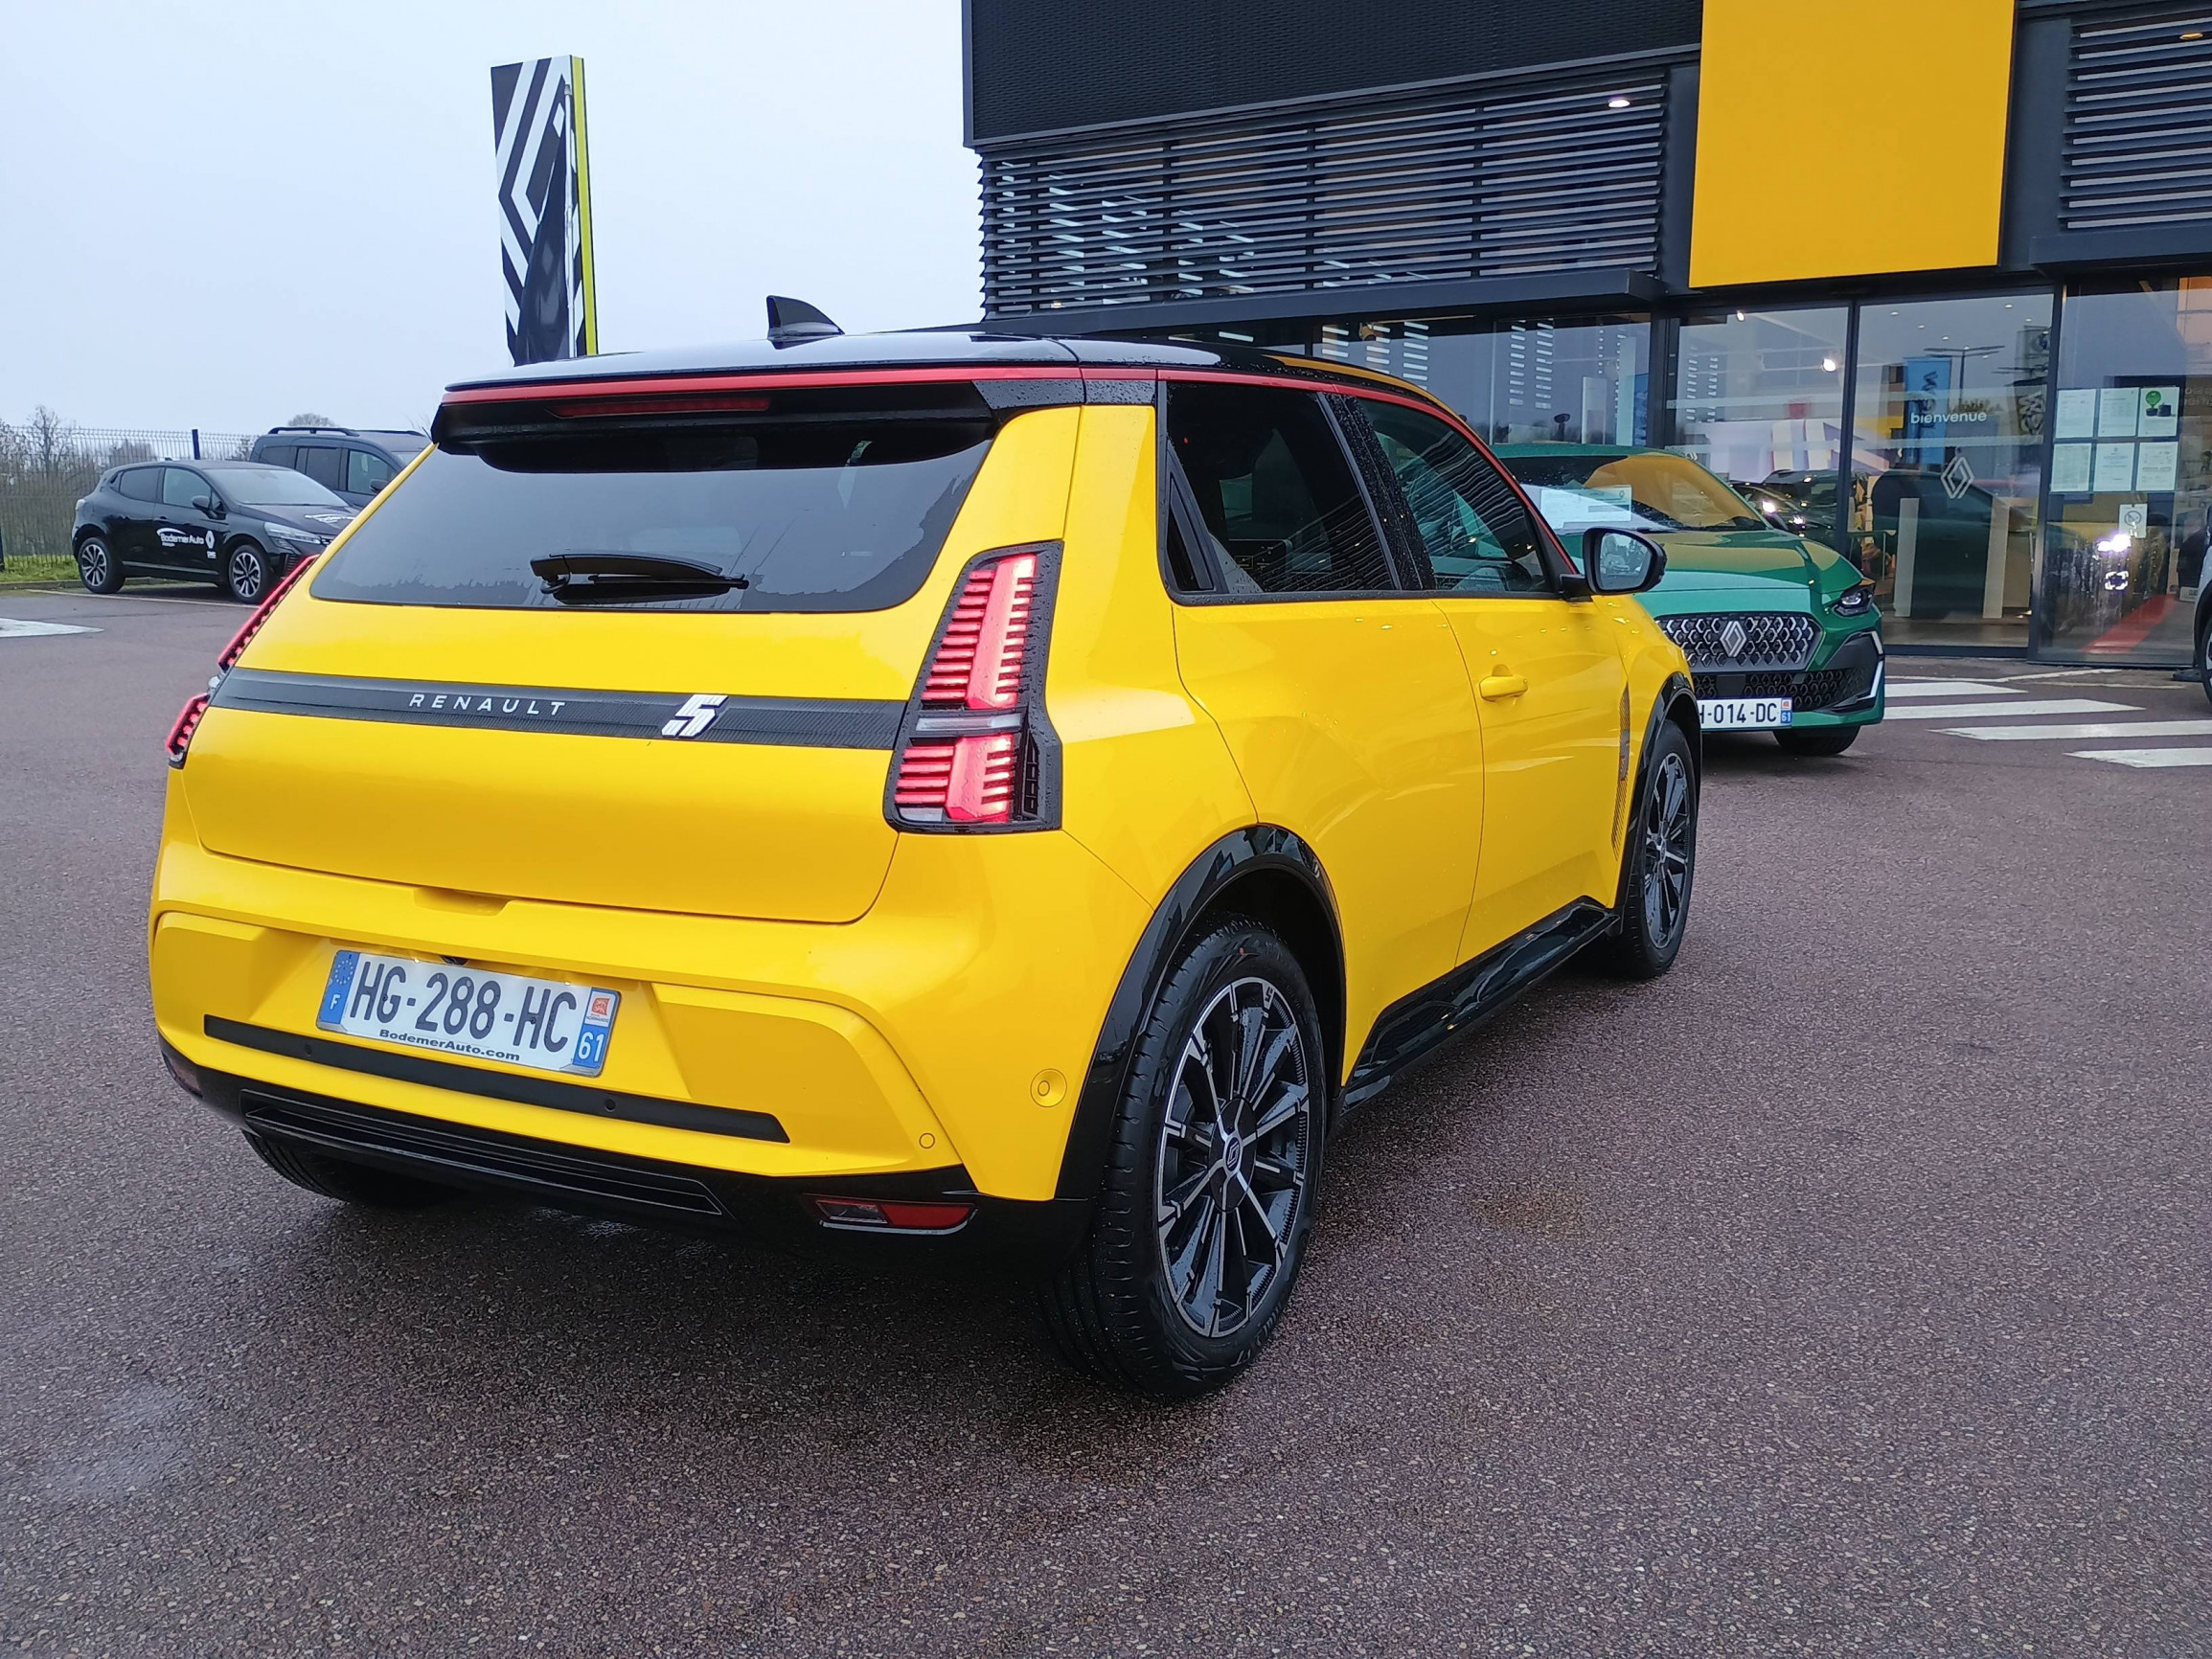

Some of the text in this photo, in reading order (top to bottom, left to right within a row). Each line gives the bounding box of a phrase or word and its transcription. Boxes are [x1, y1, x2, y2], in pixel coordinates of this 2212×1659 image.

[1910, 412, 1987, 424] bienvenue
[408, 693, 566, 716] RENAULT
[661, 693, 729, 739] 5
[1781, 712, 1791, 723] 61
[329, 993, 341, 1011] F
[349, 961, 577, 1053] HG-288-HC
[378, 1029, 520, 1061] BodemerAuto.com
[578, 1031, 605, 1062] 61
